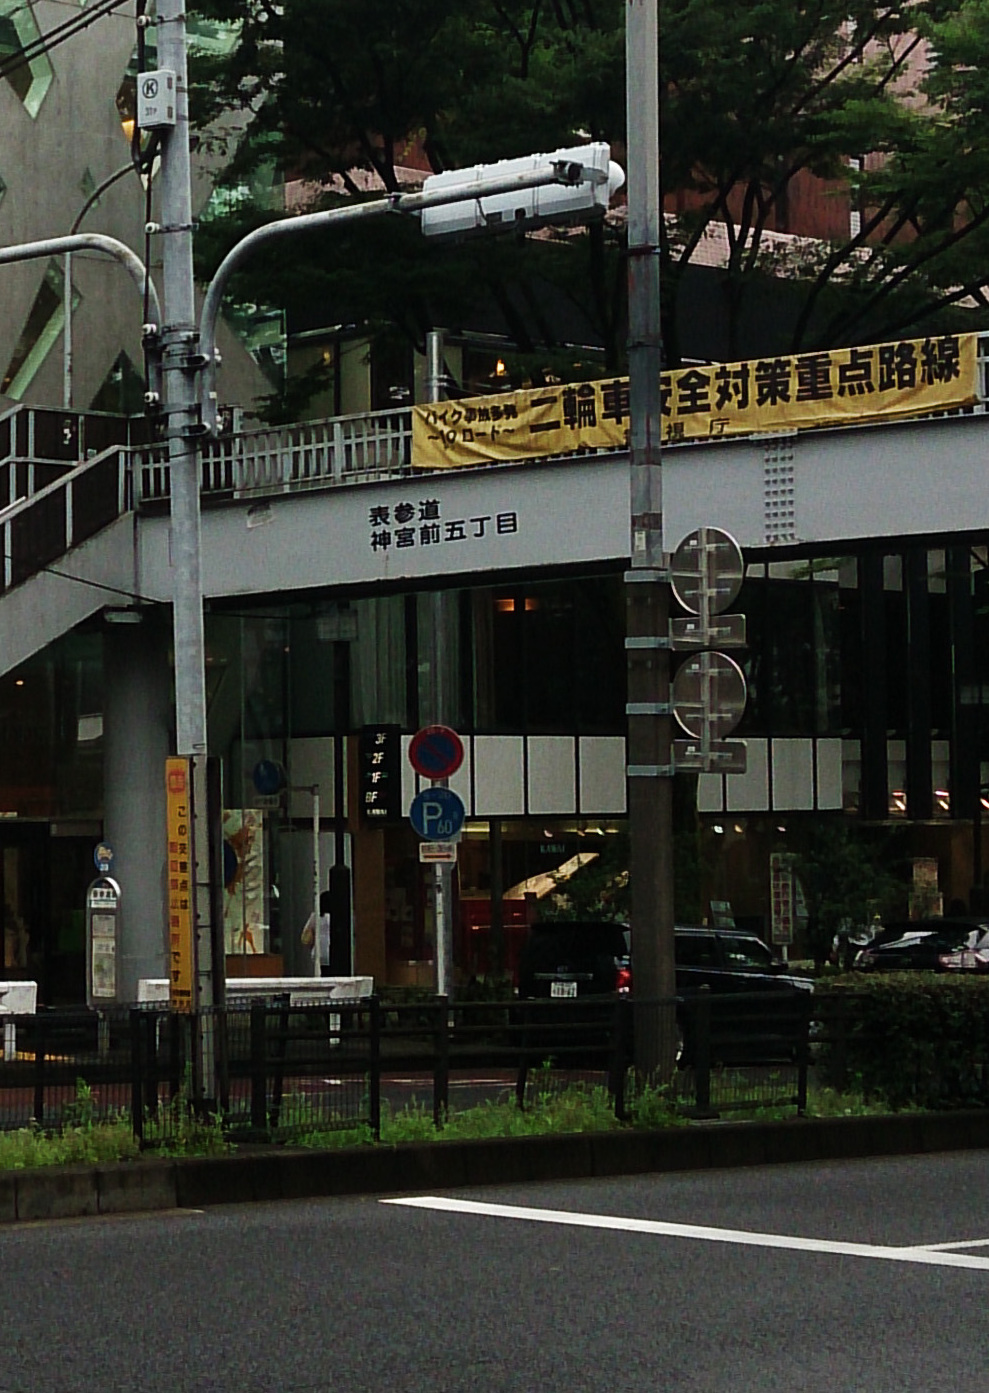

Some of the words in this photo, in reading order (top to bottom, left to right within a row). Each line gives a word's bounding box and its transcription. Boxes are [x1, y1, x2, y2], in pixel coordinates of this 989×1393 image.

[369, 499, 441, 527] 表参道
[370, 512, 518, 552] 神宮前五丁目
[374, 733, 387, 745] 3F
[371, 752, 385, 764] 2F
[371, 771, 382, 783] 1F
[422, 801, 443, 835] P
[437, 819, 453, 835] 60
